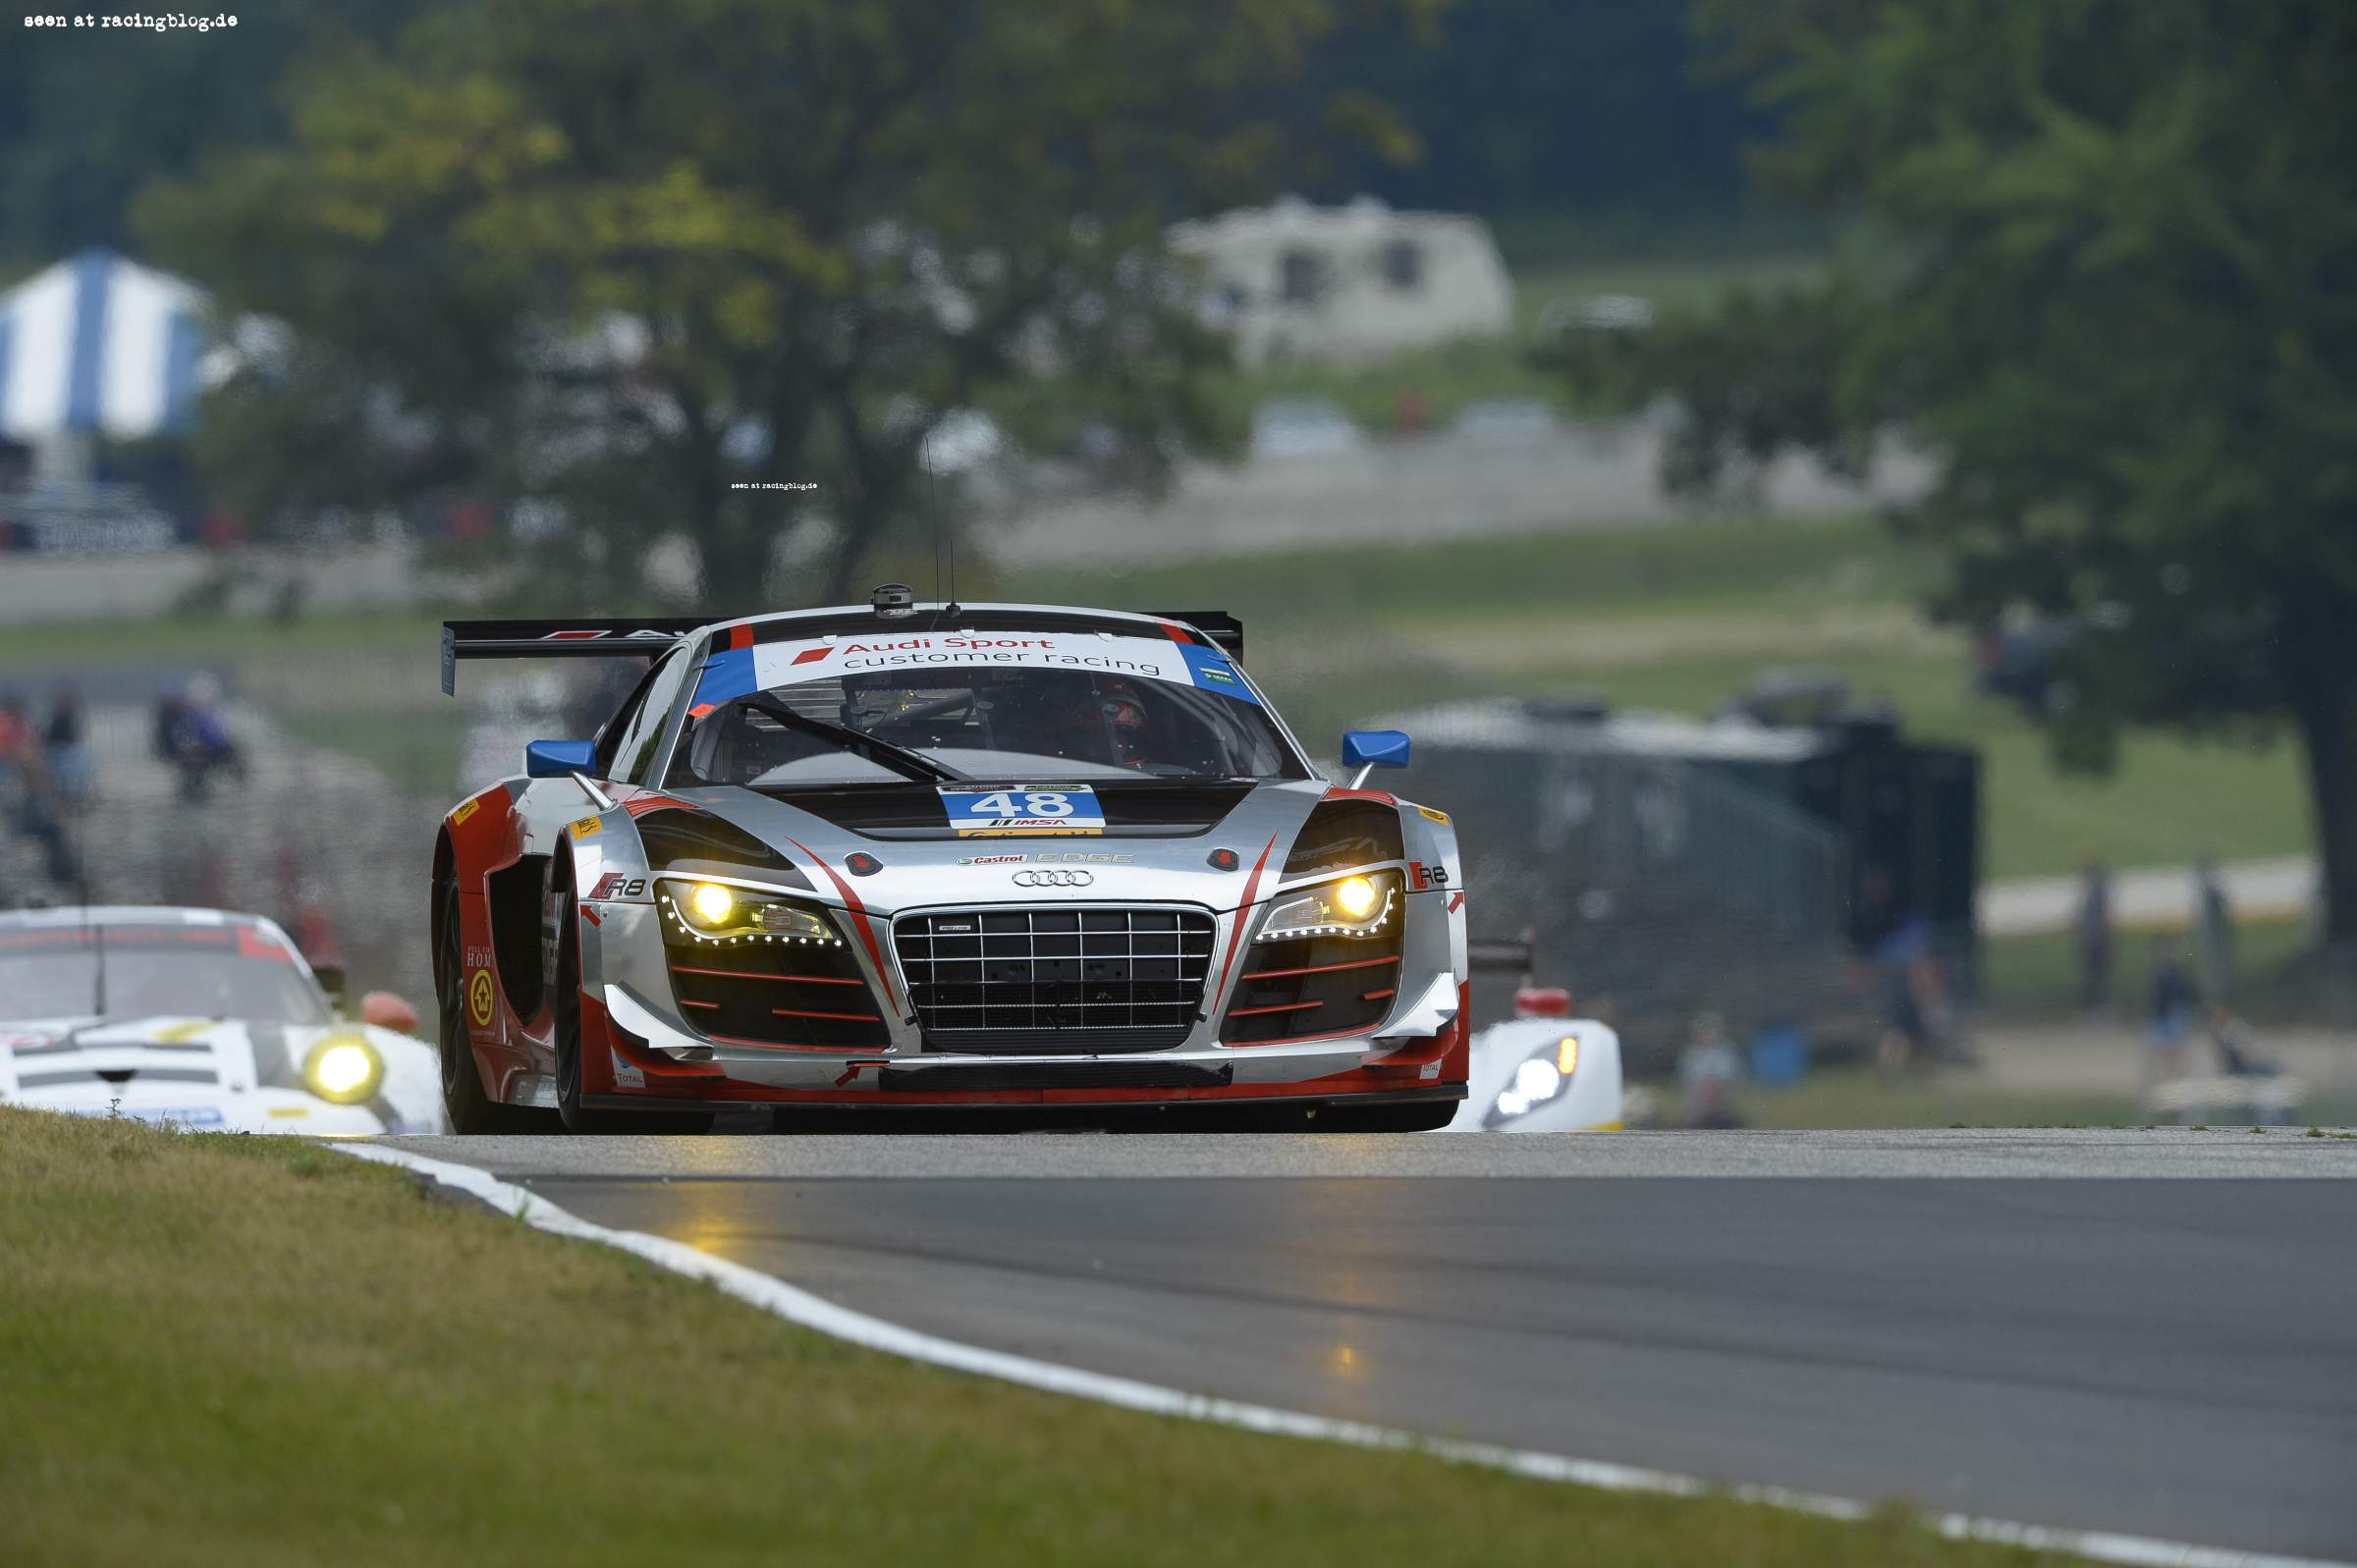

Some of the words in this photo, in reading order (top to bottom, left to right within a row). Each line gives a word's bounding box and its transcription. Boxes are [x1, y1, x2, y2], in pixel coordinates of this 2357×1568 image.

[843, 638, 931, 655] Audi
[944, 637, 1056, 650] Sport
[844, 652, 1030, 669] customer
[1044, 653, 1160, 676] racing
[970, 792, 1074, 818] 48
[973, 854, 1023, 865] Castrol
[1035, 853, 1137, 864] EDGE
[1419, 866, 1450, 885] R8
[606, 878, 646, 896] R8
